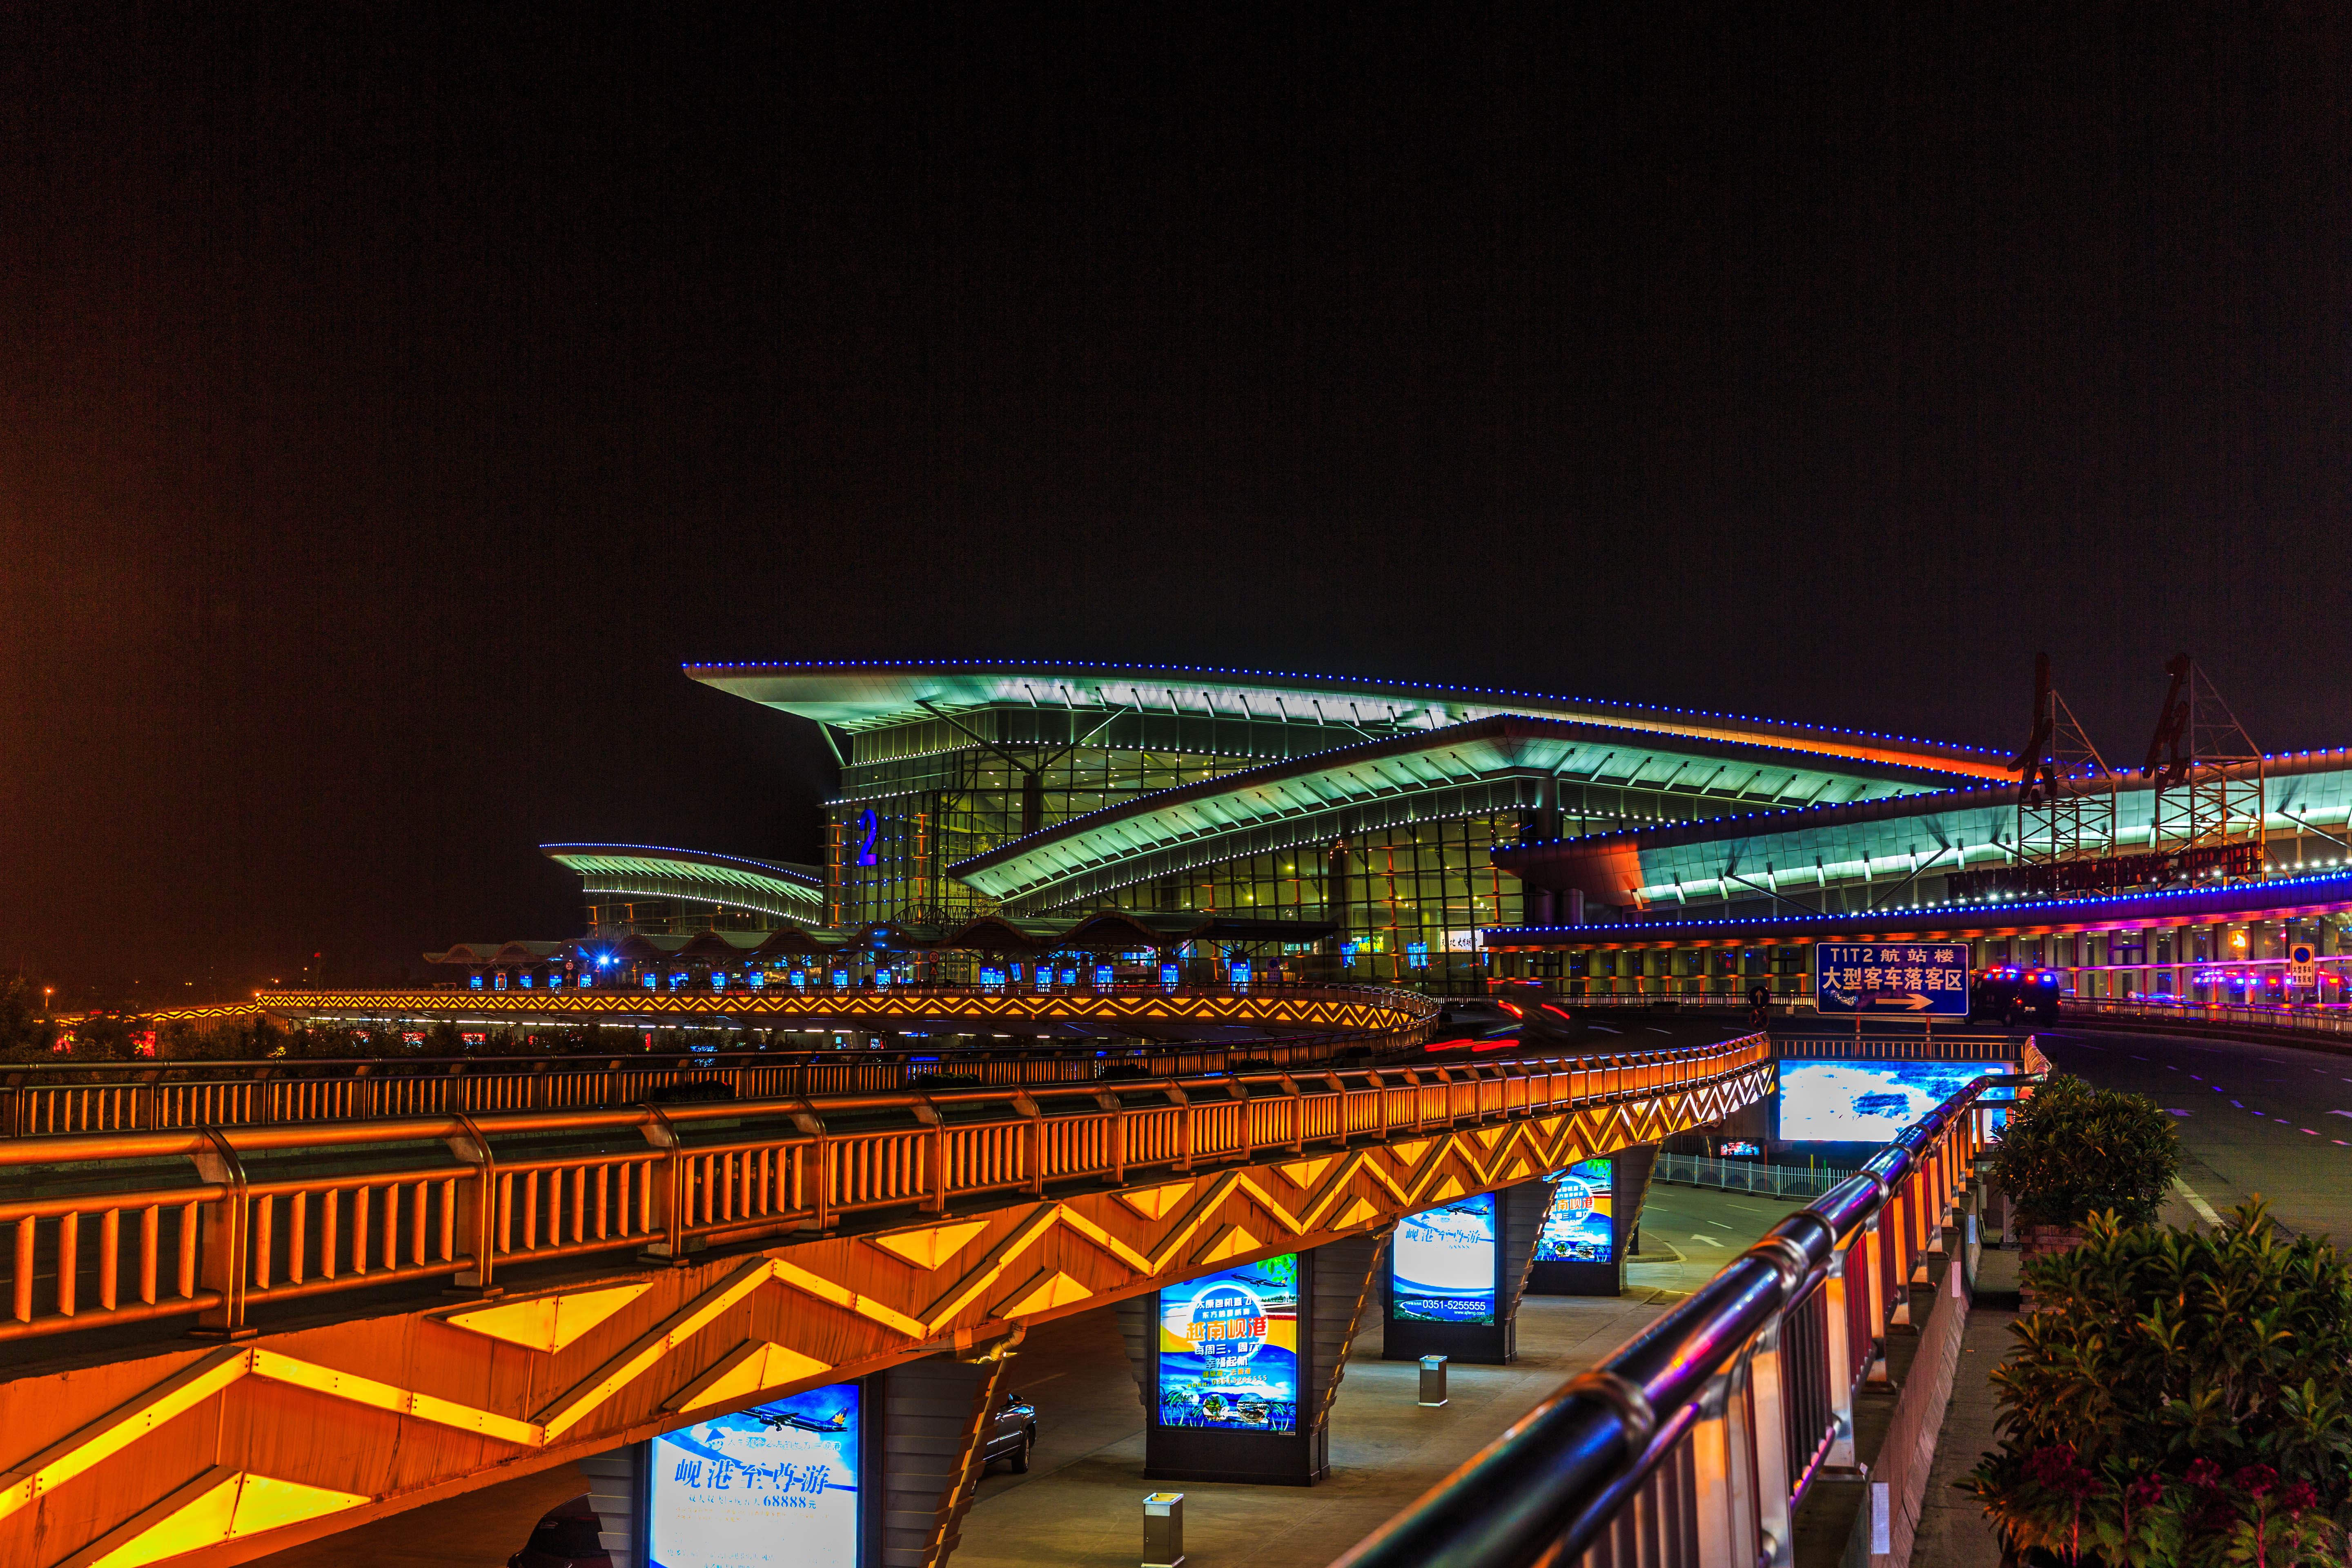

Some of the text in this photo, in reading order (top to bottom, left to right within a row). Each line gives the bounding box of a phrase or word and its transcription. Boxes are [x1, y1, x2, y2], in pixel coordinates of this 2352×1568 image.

[859, 809, 877, 866] 2
[1831, 948, 1954, 962] T1T2 航站楼
[1823, 966, 1962, 991] 大型客车落客区
[1196, 1296, 1252, 1310] 太原包机直飞
[1423, 1300, 1486, 1310] 0351-5255555
[1187, 1316, 1266, 1342] 越南岘港
[1195, 1341, 1260, 1356] 每周三、周六
[1206, 1356, 1249, 1369] 幸福起航
[675, 1459, 830, 1494] 岘港至尊游
